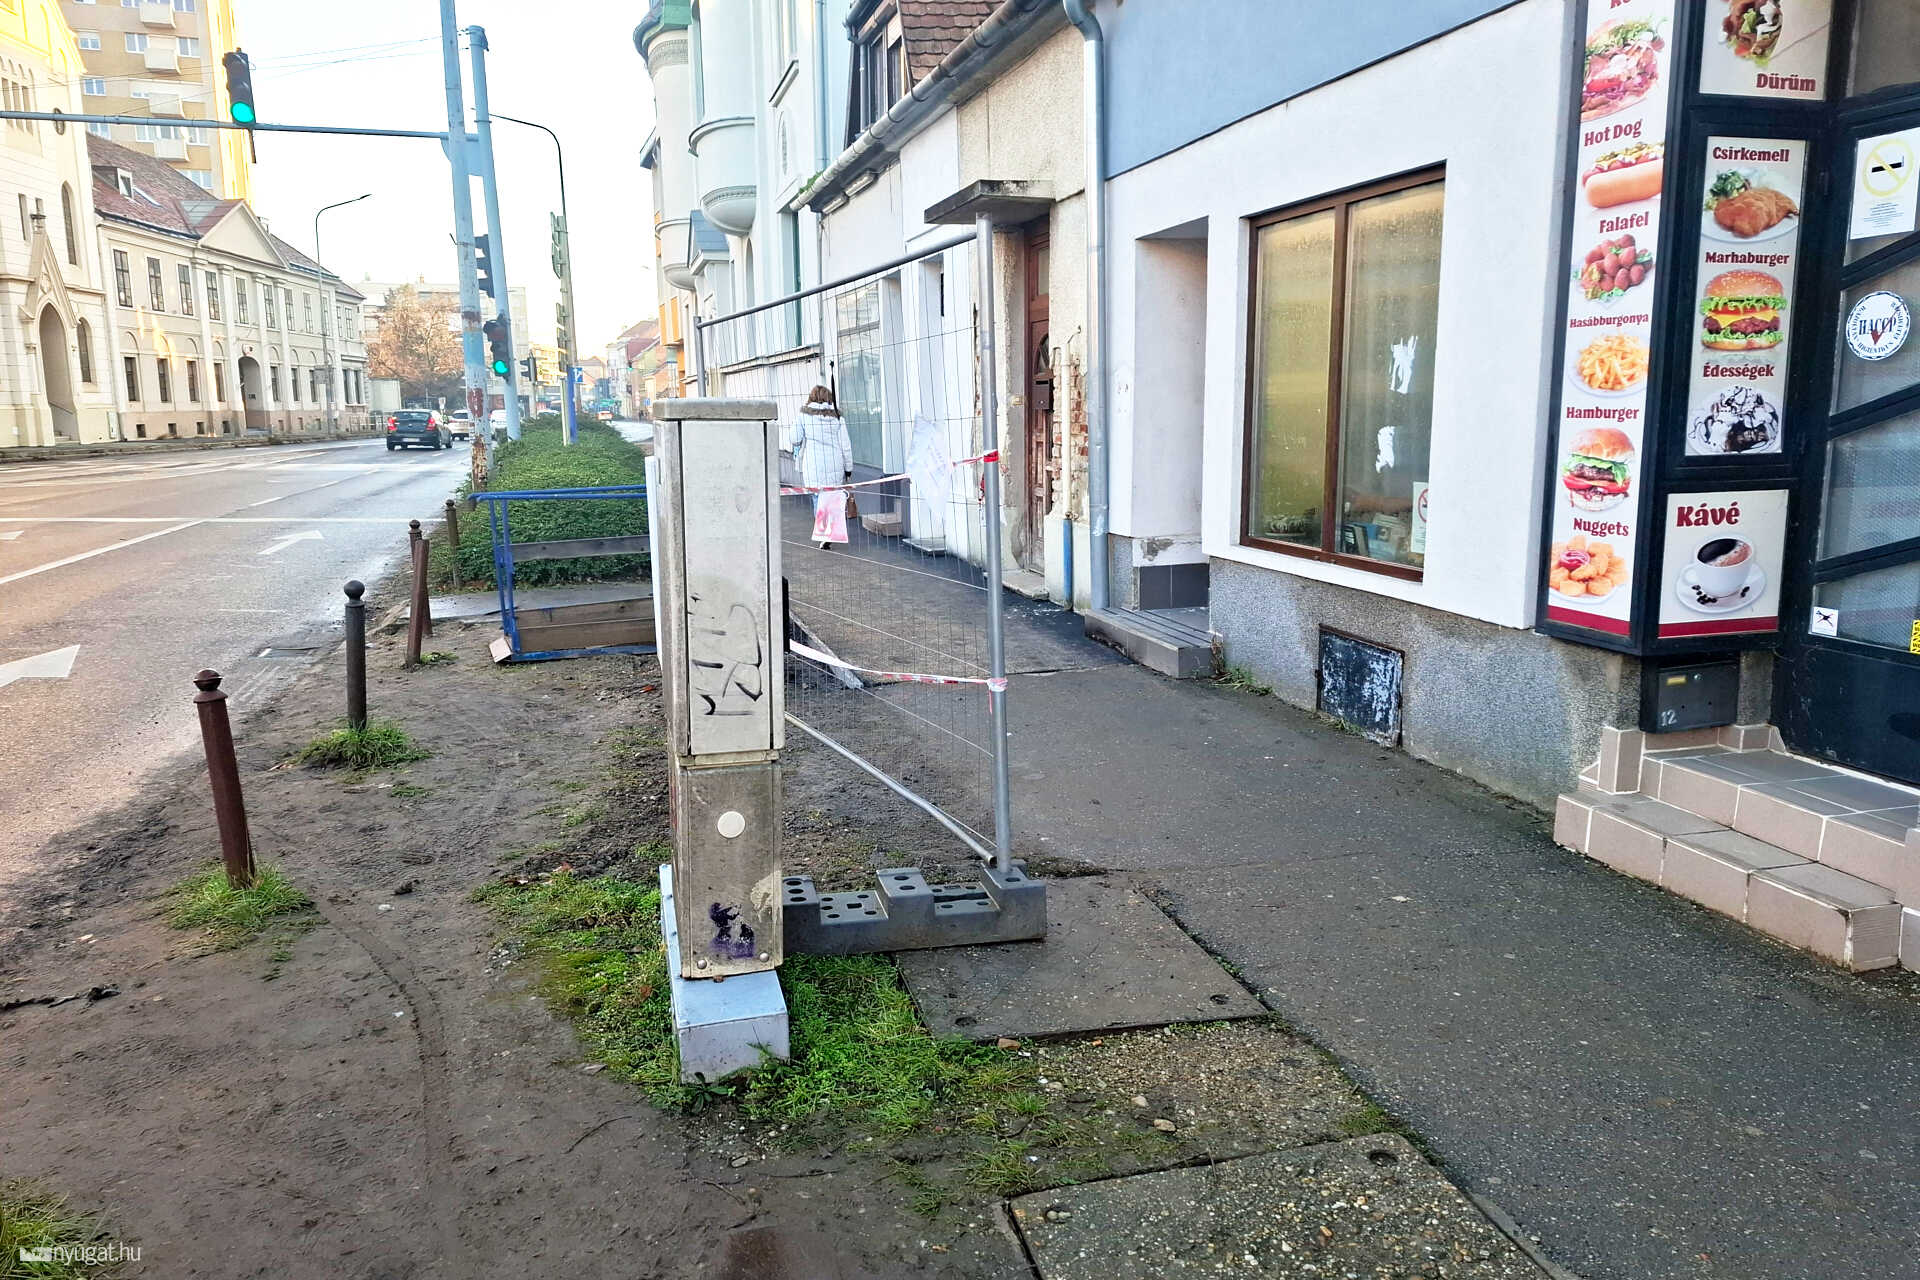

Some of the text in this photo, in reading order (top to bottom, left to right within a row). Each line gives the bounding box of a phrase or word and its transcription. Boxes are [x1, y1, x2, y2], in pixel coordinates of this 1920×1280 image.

[1756, 73, 1816, 92] Dürüm
[1584, 119, 1643, 146] Hot Dog
[1713, 147, 1789, 162] Csirkemell
[1599, 212, 1649, 233] Falafel
[1705, 251, 1790, 267] Marhaburger
[1569, 312, 1649, 329] Hasábburgonya
[1703, 362, 1774, 380] Édességek
[1567, 407, 1639, 422] Hamburger
[1677, 502, 1740, 527] Kávé
[1574, 518, 1628, 537] Nuggets
[1662, 709, 1677, 727] 12
